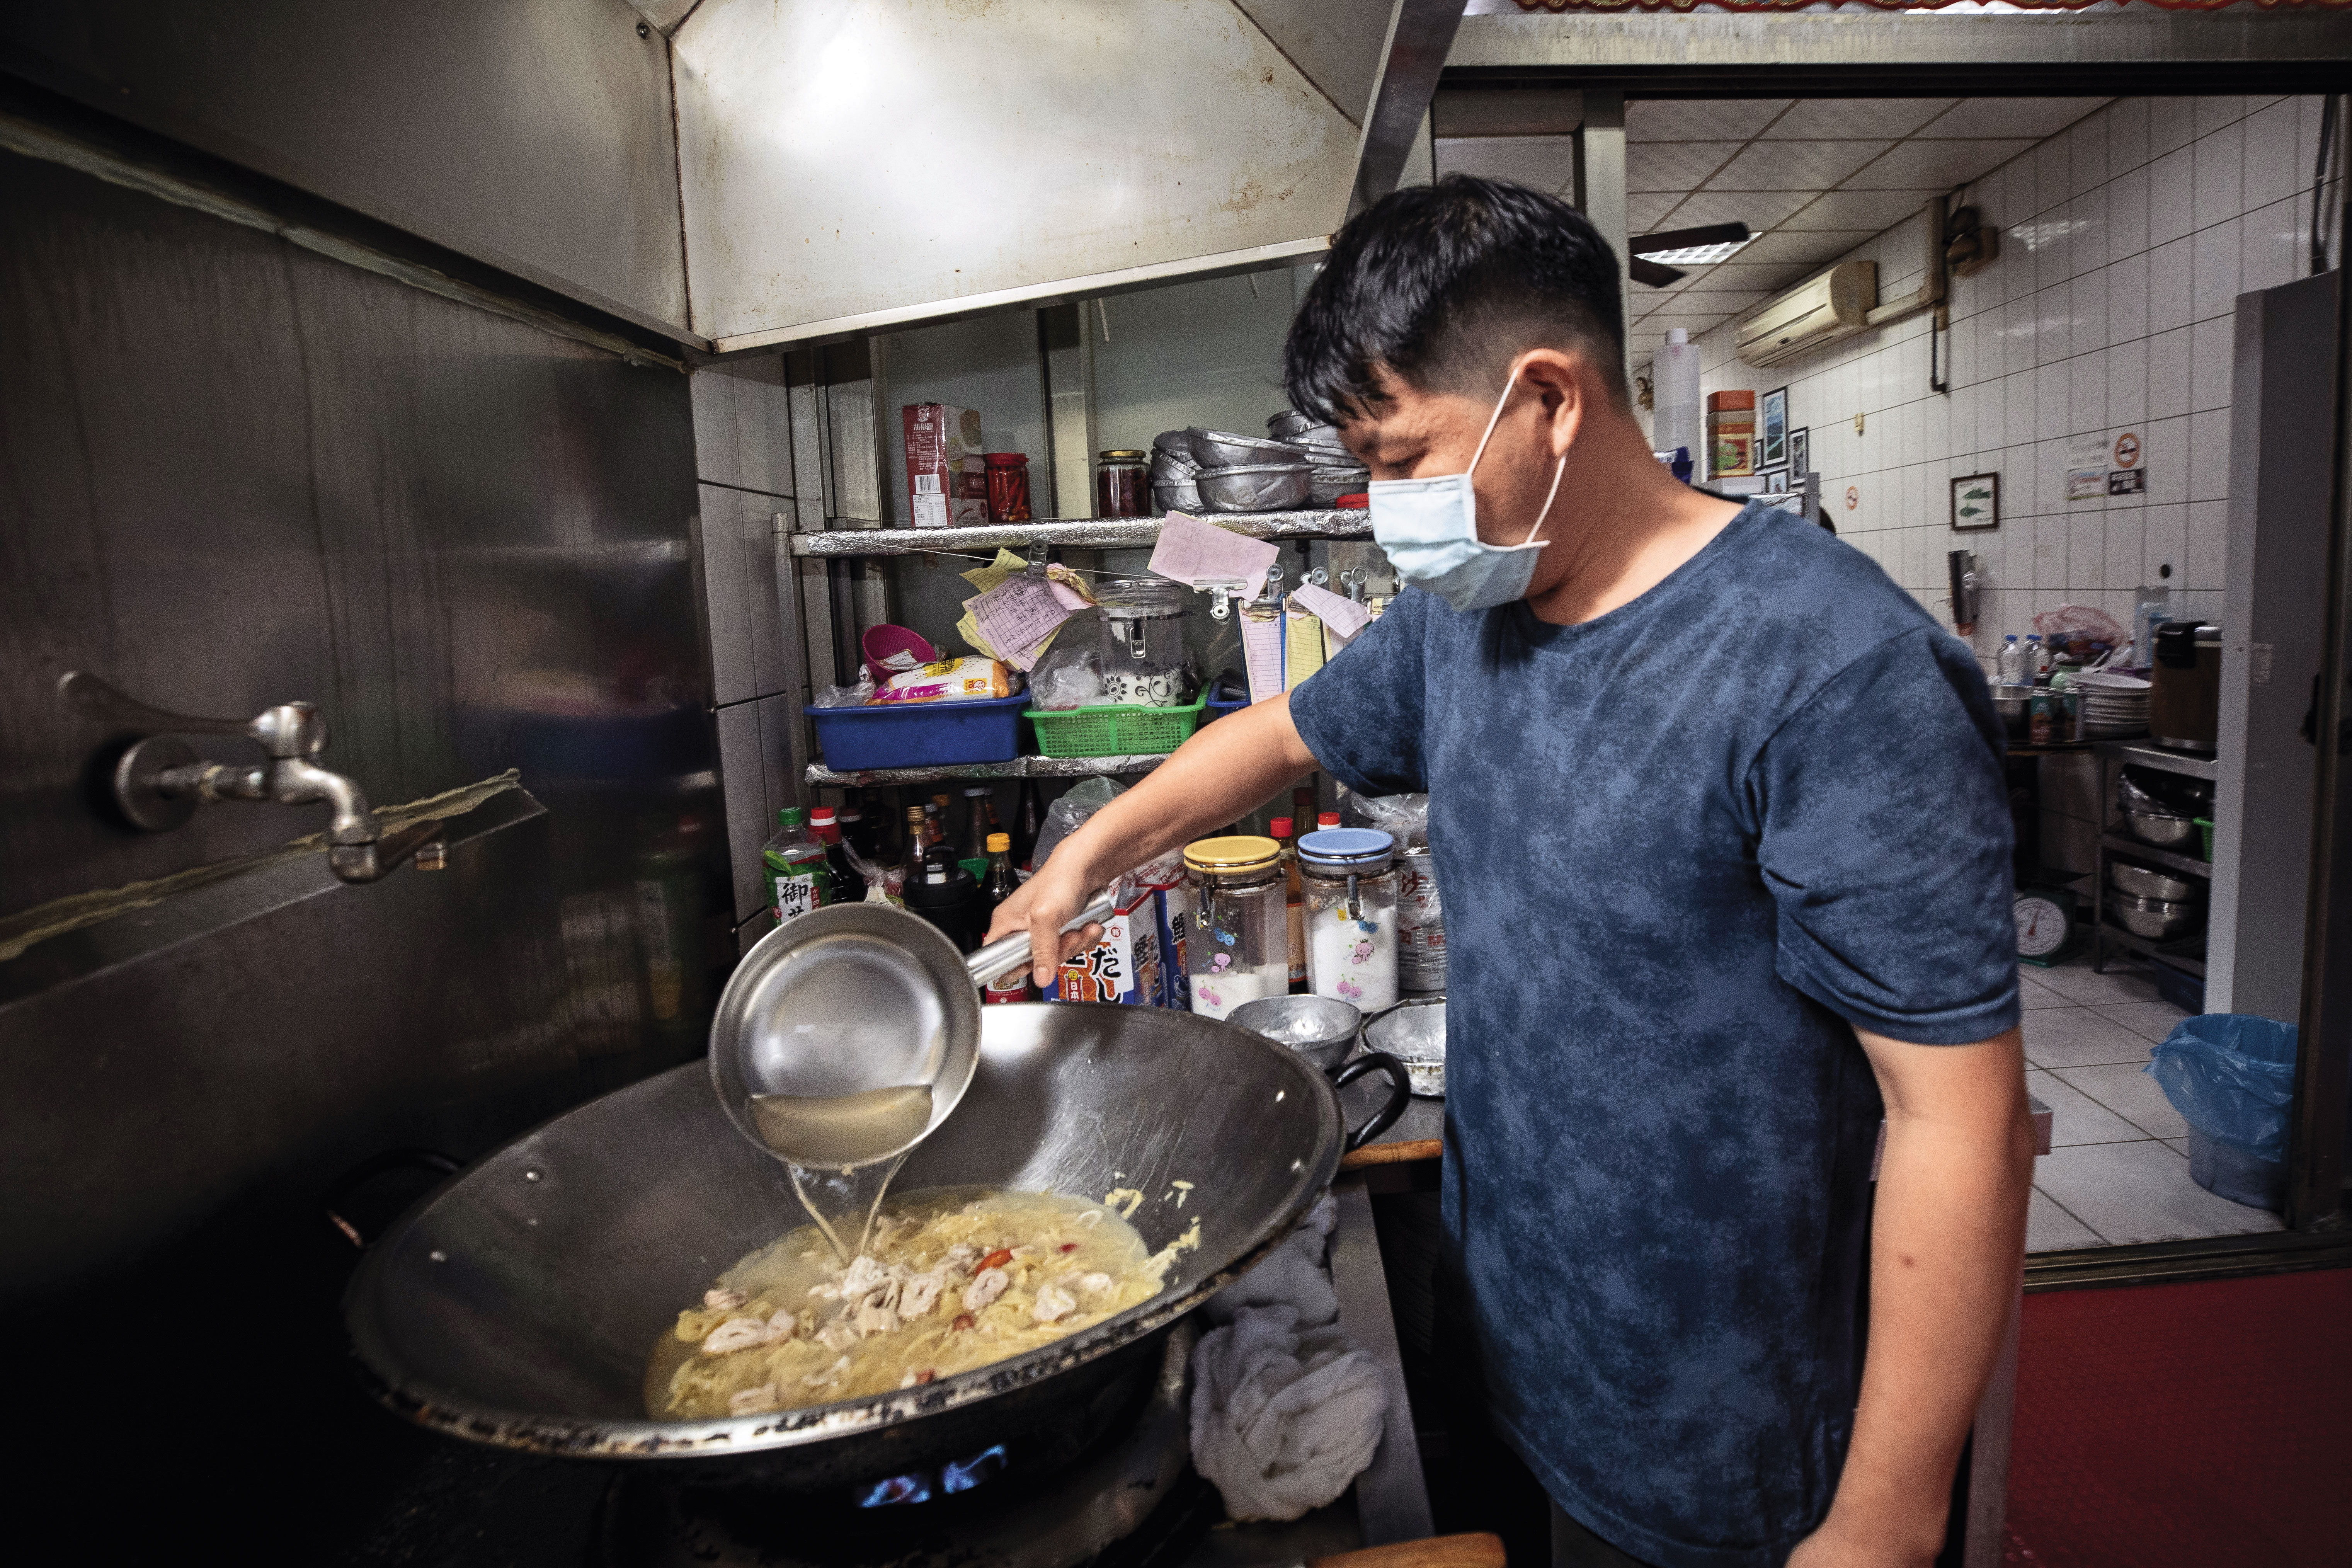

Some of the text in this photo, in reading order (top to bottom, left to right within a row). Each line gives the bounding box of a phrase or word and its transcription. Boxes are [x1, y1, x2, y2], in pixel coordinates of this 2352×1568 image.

[914, 422, 933, 431] 胡椒鹽
[1091, 947, 1122, 1003] だし
[1070, 982, 1079, 1002] 日本
